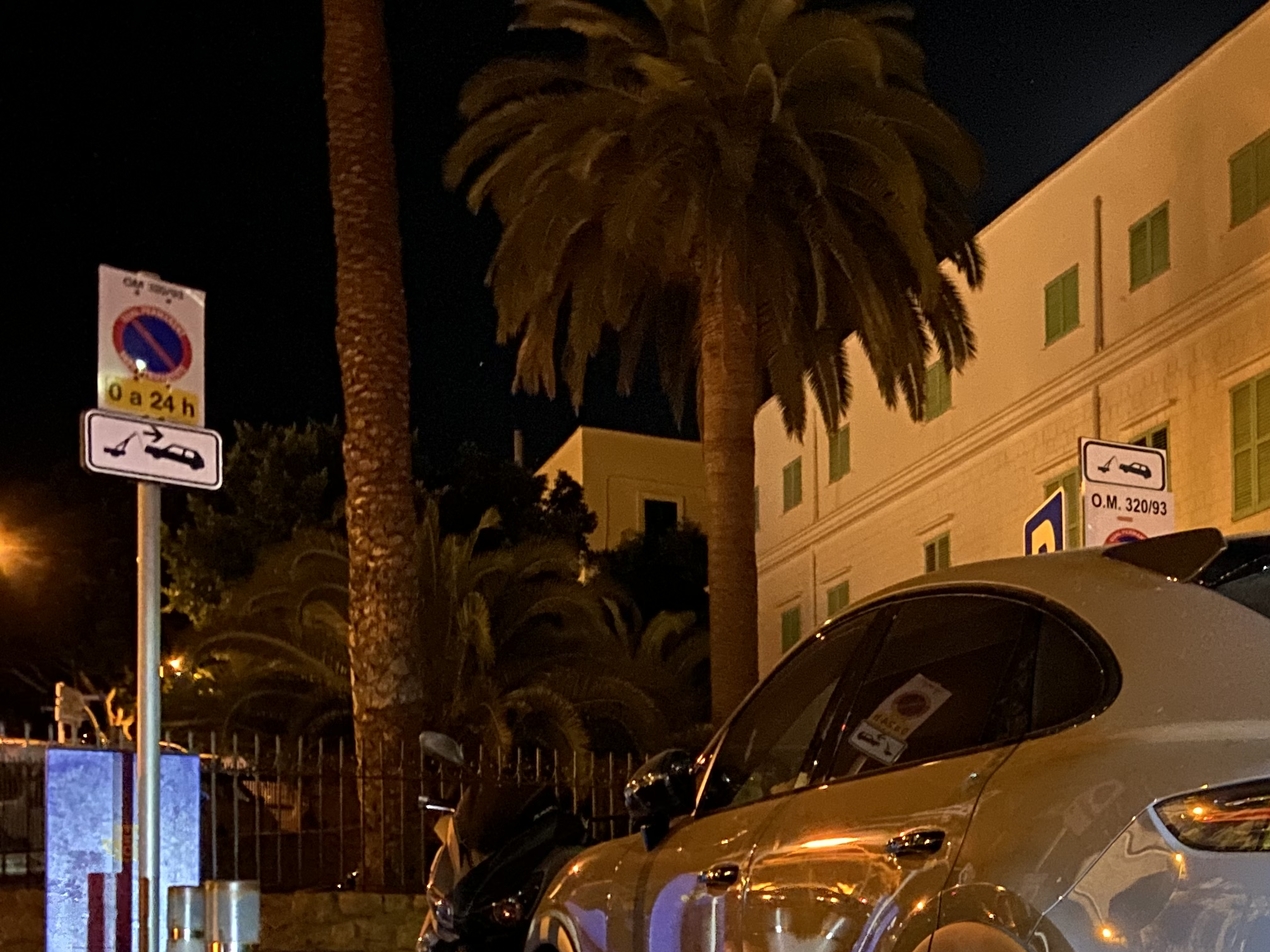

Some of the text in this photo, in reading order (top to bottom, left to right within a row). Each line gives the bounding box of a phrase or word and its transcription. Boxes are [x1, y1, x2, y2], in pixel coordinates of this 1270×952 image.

[109, 383, 196, 418] 0 a 24 h
[1091, 493, 1168, 516] O.M. 320/93
